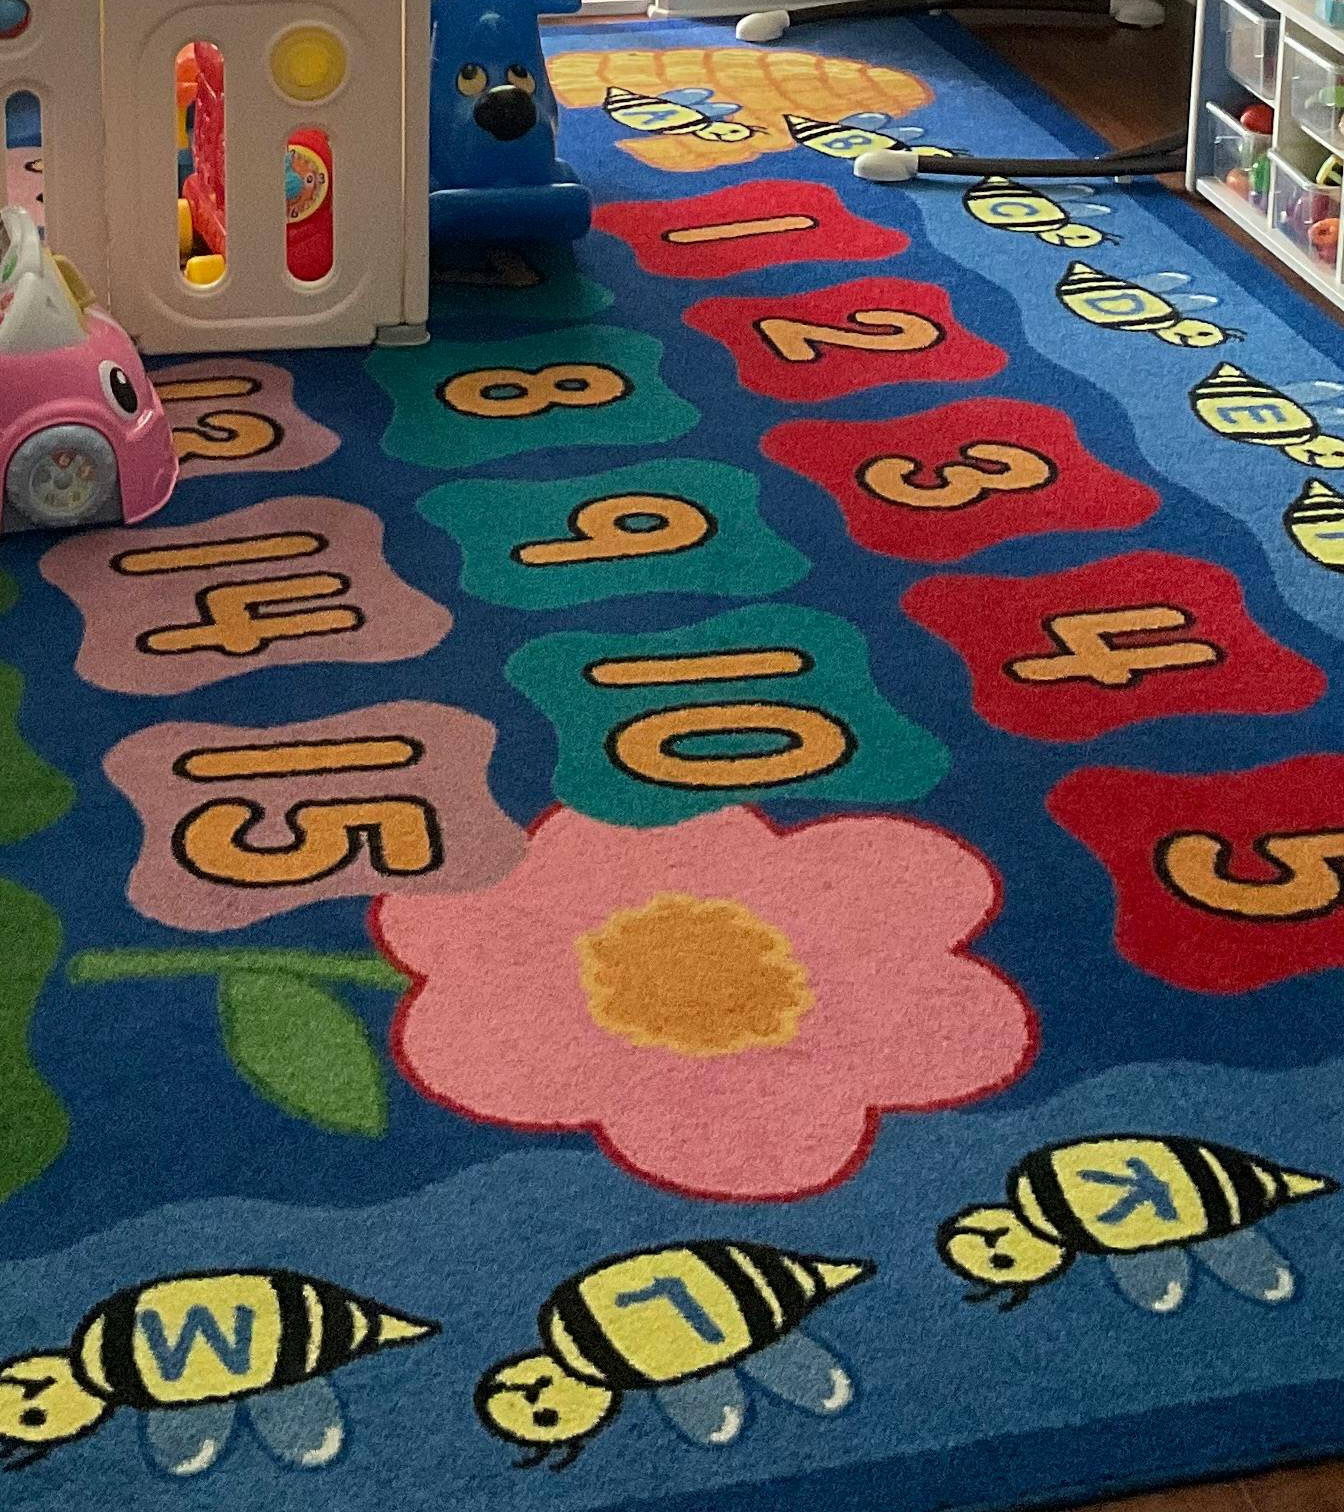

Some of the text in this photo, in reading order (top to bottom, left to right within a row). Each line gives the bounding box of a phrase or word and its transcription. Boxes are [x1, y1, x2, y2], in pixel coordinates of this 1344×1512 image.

[622, 109, 680, 125] A
[822, 134, 872, 150] B
[665, 213, 813, 247] 1
[989, 201, 1040, 216] C
[757, 307, 941, 365] 2
[1084, 293, 1145, 315] D
[441, 362, 628, 421] 8
[1216, 404, 1287, 424] E
[860, 439, 1052, 512] 3
[518, 492, 711, 568] 9
[118, 532, 360, 657] 14
[1006, 600, 1222, 691] 4
[585, 645, 852, 792] 10
[177, 734, 438, 889] 15
[1075, 1156, 1179, 1223] K
[138, 1304, 256, 1381] M
[613, 1276, 726, 1345] L
